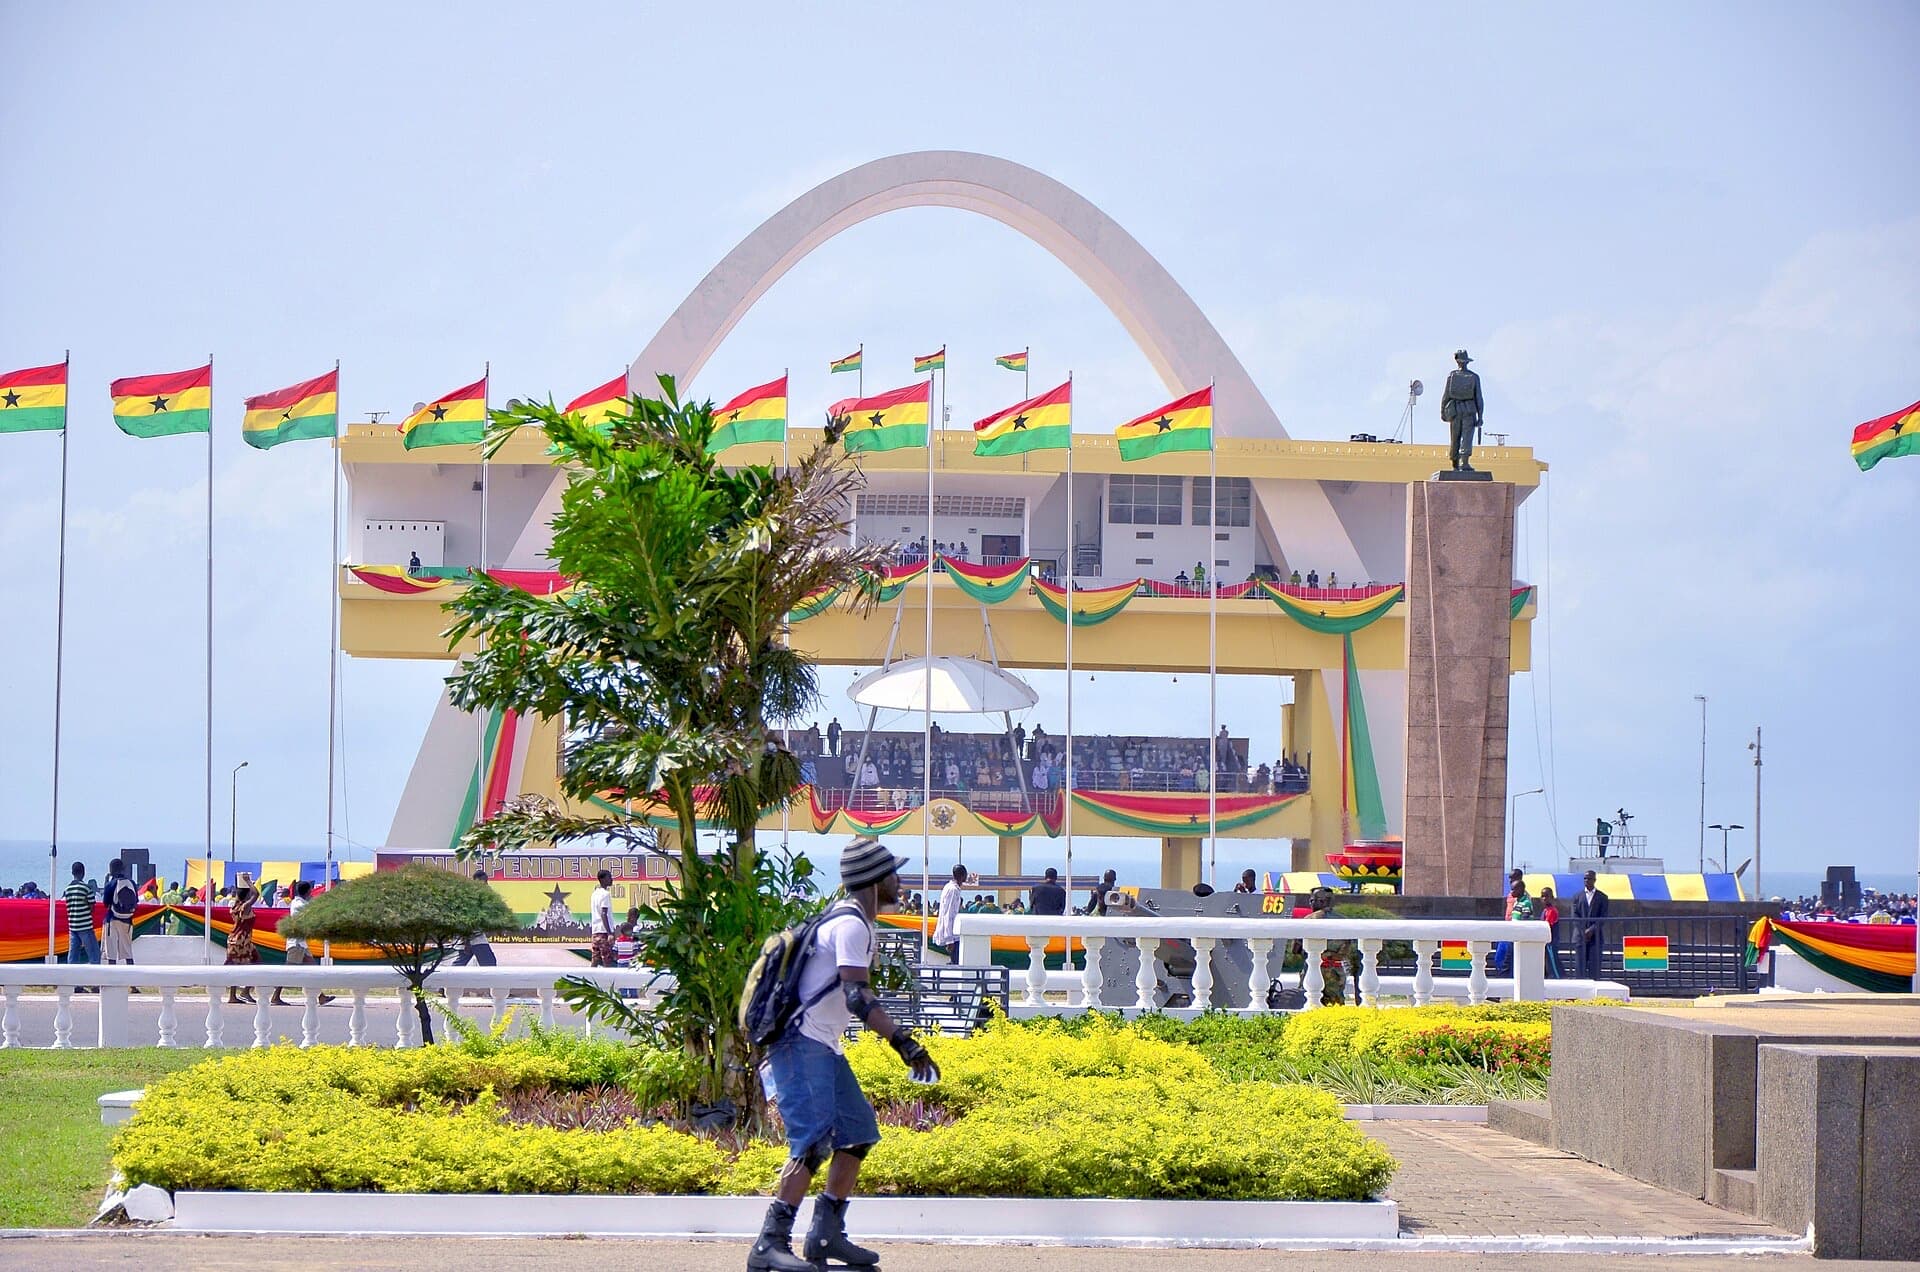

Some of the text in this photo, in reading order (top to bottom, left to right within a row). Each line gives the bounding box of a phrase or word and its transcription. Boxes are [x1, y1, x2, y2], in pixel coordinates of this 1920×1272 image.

[413, 857, 680, 878] DEPENDENCE DA
[1263, 895, 1284, 914] 66
